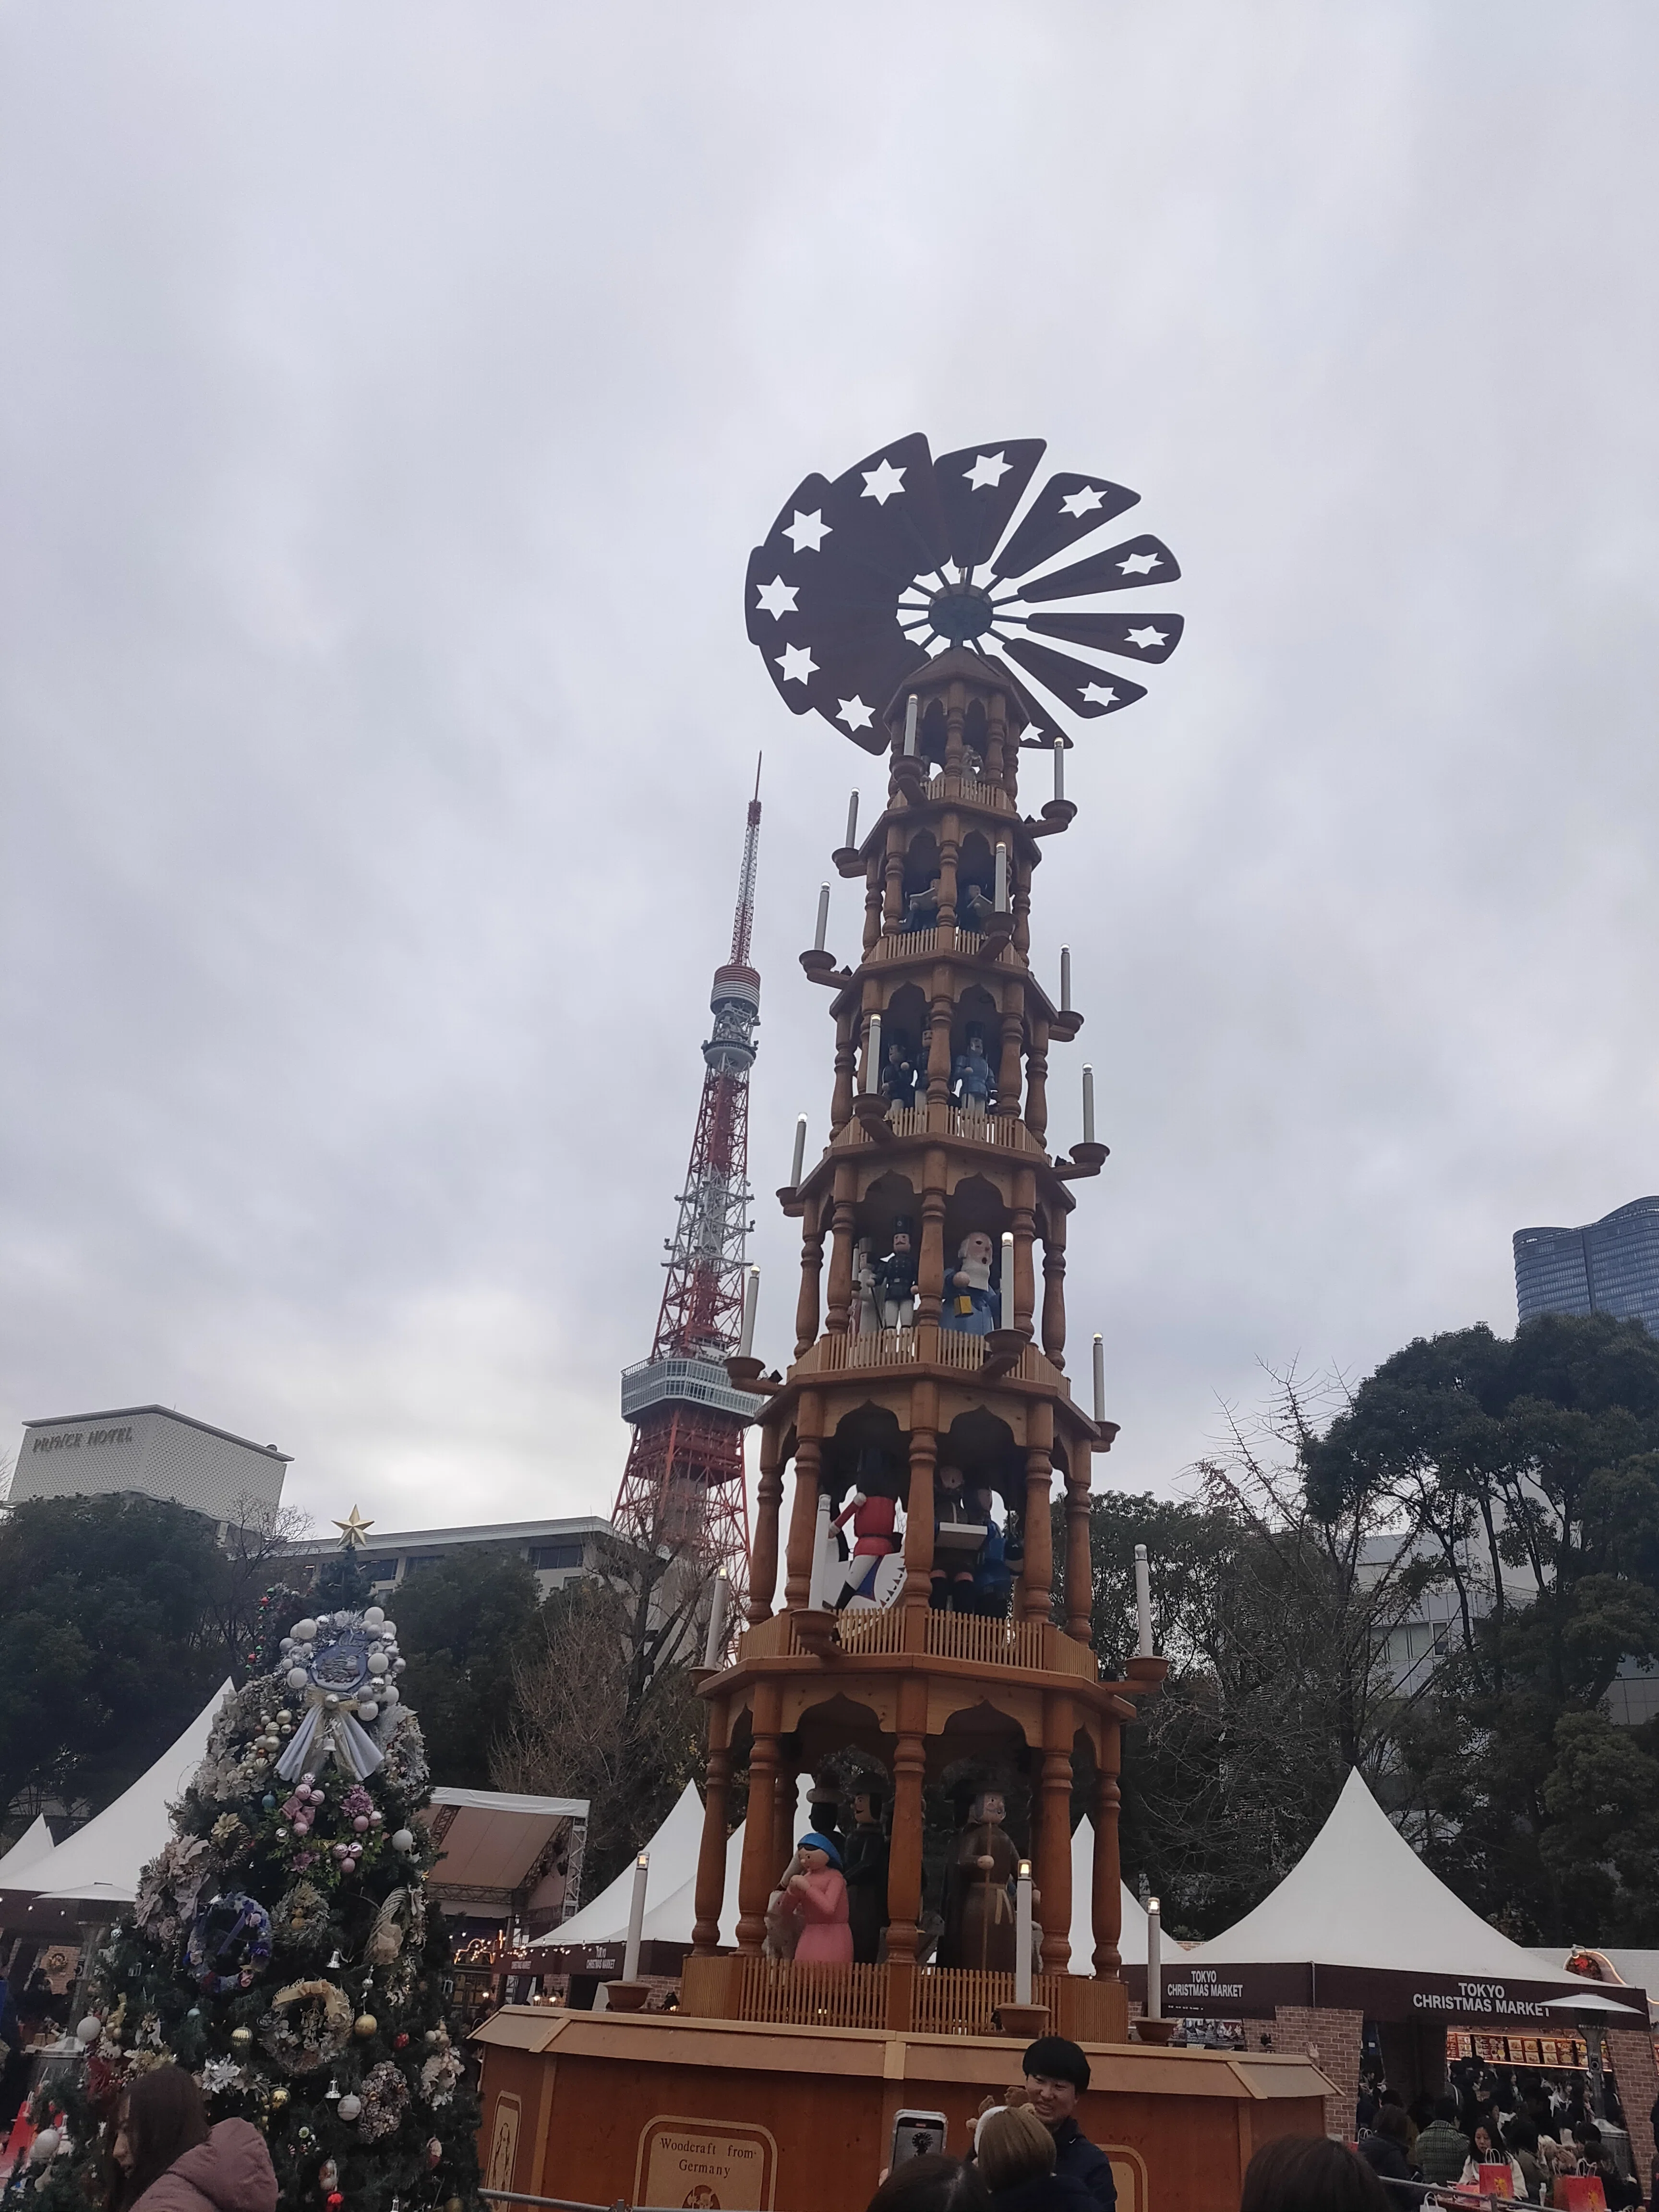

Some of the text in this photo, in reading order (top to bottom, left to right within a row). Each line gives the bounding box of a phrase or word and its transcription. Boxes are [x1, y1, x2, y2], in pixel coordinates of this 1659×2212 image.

[33, 1427, 132, 1453] PRINCE HOTEL
[1191, 1970, 1216, 1983] TOKYO
[1167, 1984, 1243, 1997] CHRISTMAS MARKET
[1458, 1982, 1505, 1998] TOKYO
[1413, 1994, 1492, 2012] CHRISTMAS
[661, 2138, 753, 2159] Woodcraft from
[679, 2159, 731, 2178] Germany
